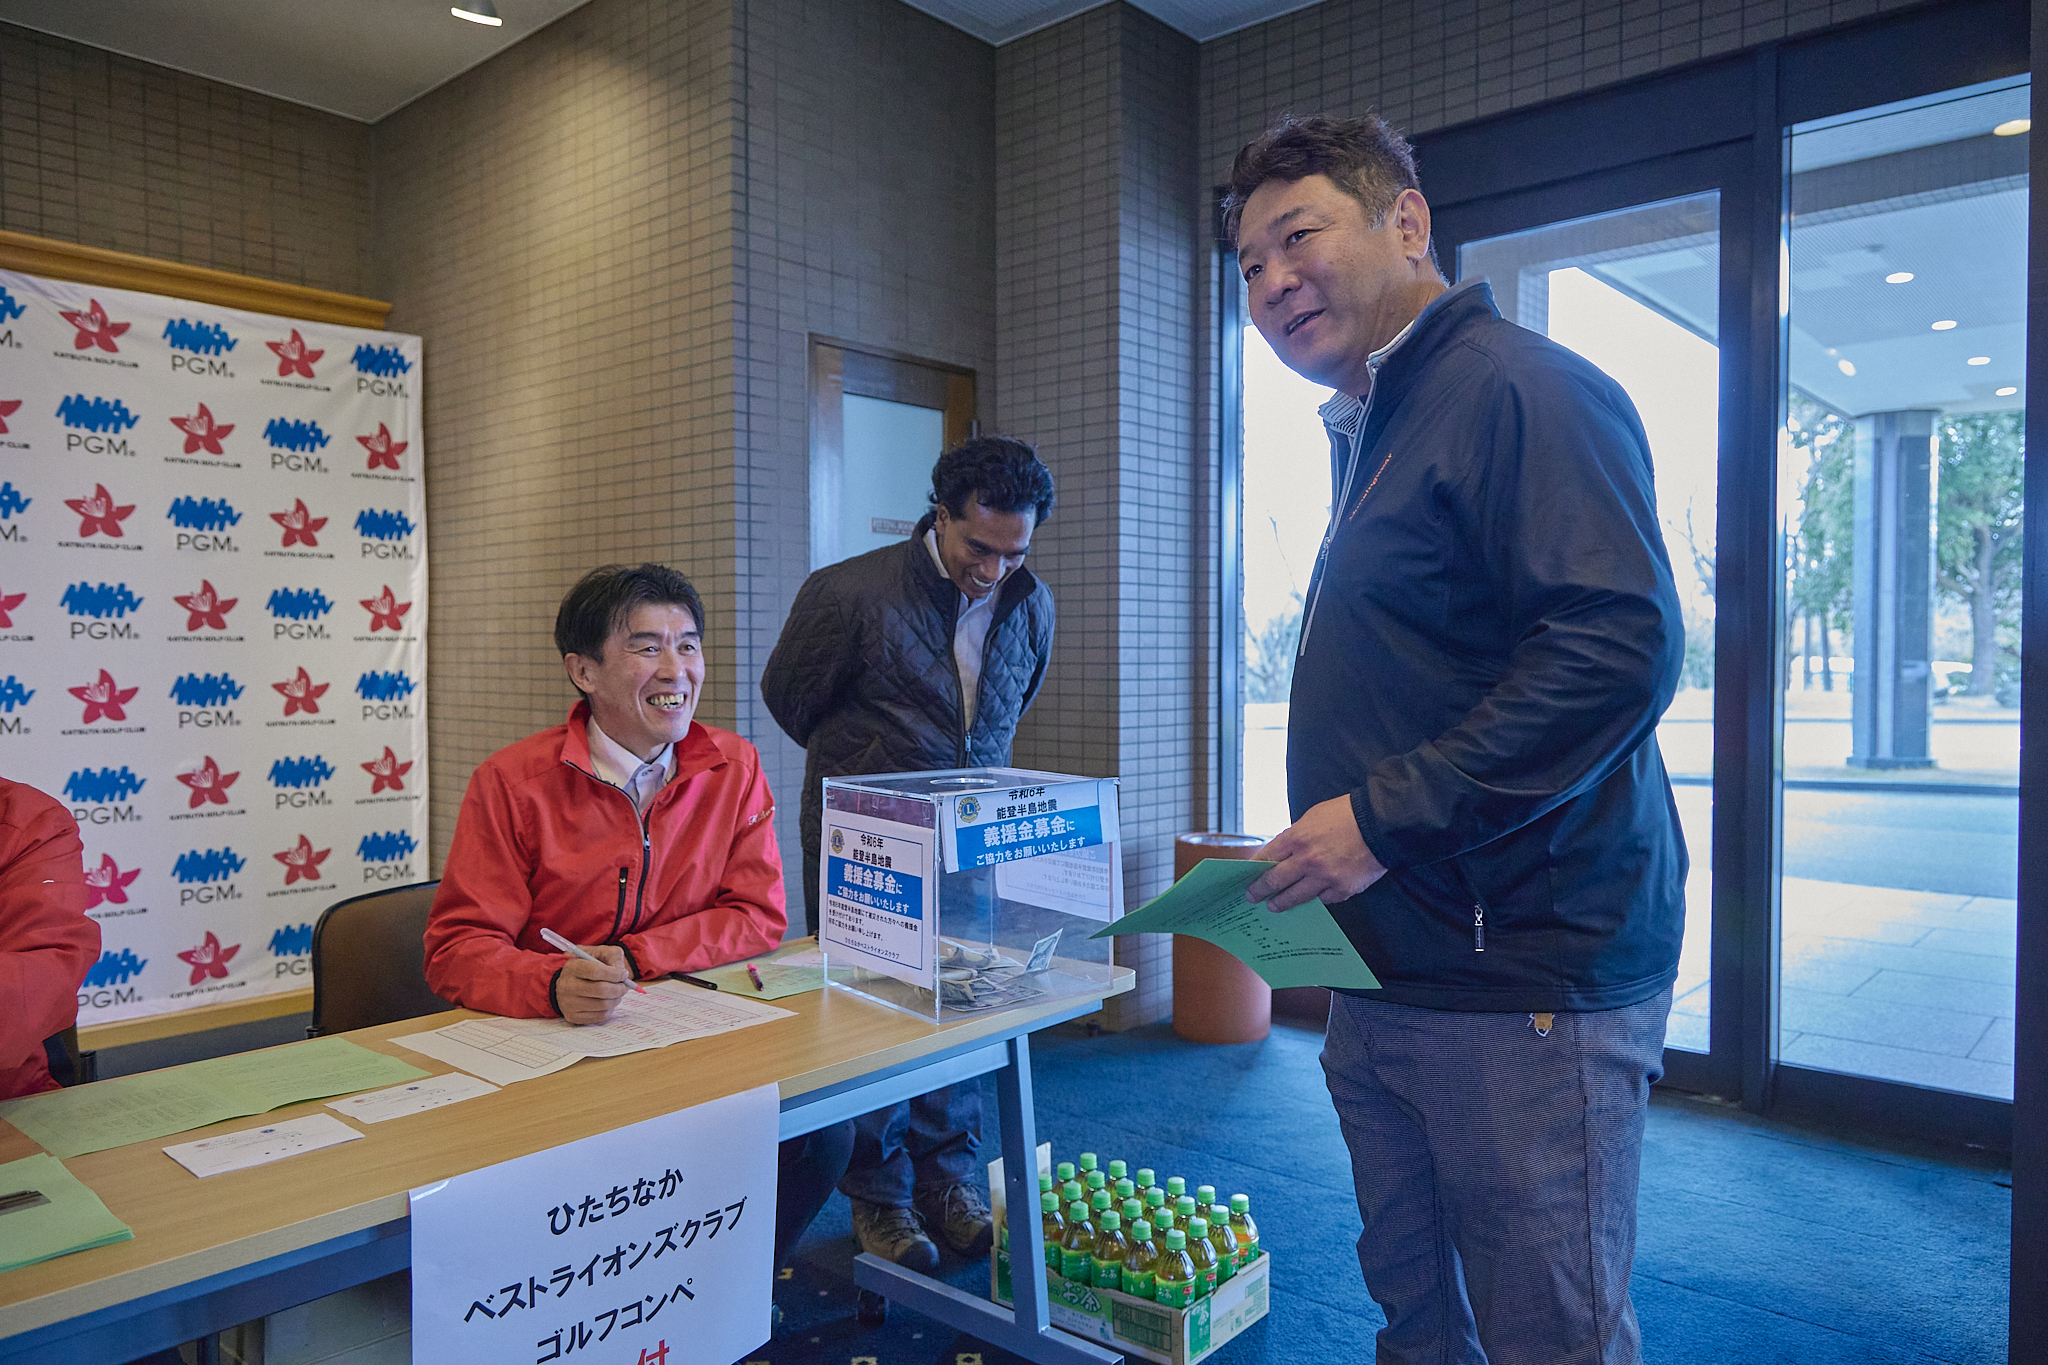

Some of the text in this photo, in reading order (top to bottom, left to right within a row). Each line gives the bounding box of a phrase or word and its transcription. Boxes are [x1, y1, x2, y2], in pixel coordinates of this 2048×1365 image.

[172, 354, 230, 376] PGM
[357, 376, 405, 397] PGM
[67, 432, 127, 455] PGM
[271, 452, 324, 472] PGM
[177, 534, 235, 551] PGM
[362, 543, 409, 559] PGM
[71, 622, 131, 639] PGM
[274, 623, 325, 640] PGM
[179, 710, 237, 728] PGM
[362, 704, 412, 721] PGM
[276, 790, 328, 809] PGM
[996, 799, 1058, 820] 能登半島地震
[860, 834, 884, 849] 令和6年
[983, 815, 1076, 848] 義援金募金に
[852, 848, 892, 868] 能登半島地震
[976, 836, 1086, 866] ご協力をお願いいたします
[364, 864, 412, 882] PGM
[843, 863, 903, 895] 義援金募金に
[181, 883, 238, 906] PGM
[837, 885, 910, 914] ご協力をお願いいたします
[546, 1168, 684, 1236] ひたちなか
[463, 1196, 748, 1323] ベストライオンズクラブ
[536, 1277, 695, 1365] ゴルフコンペ
